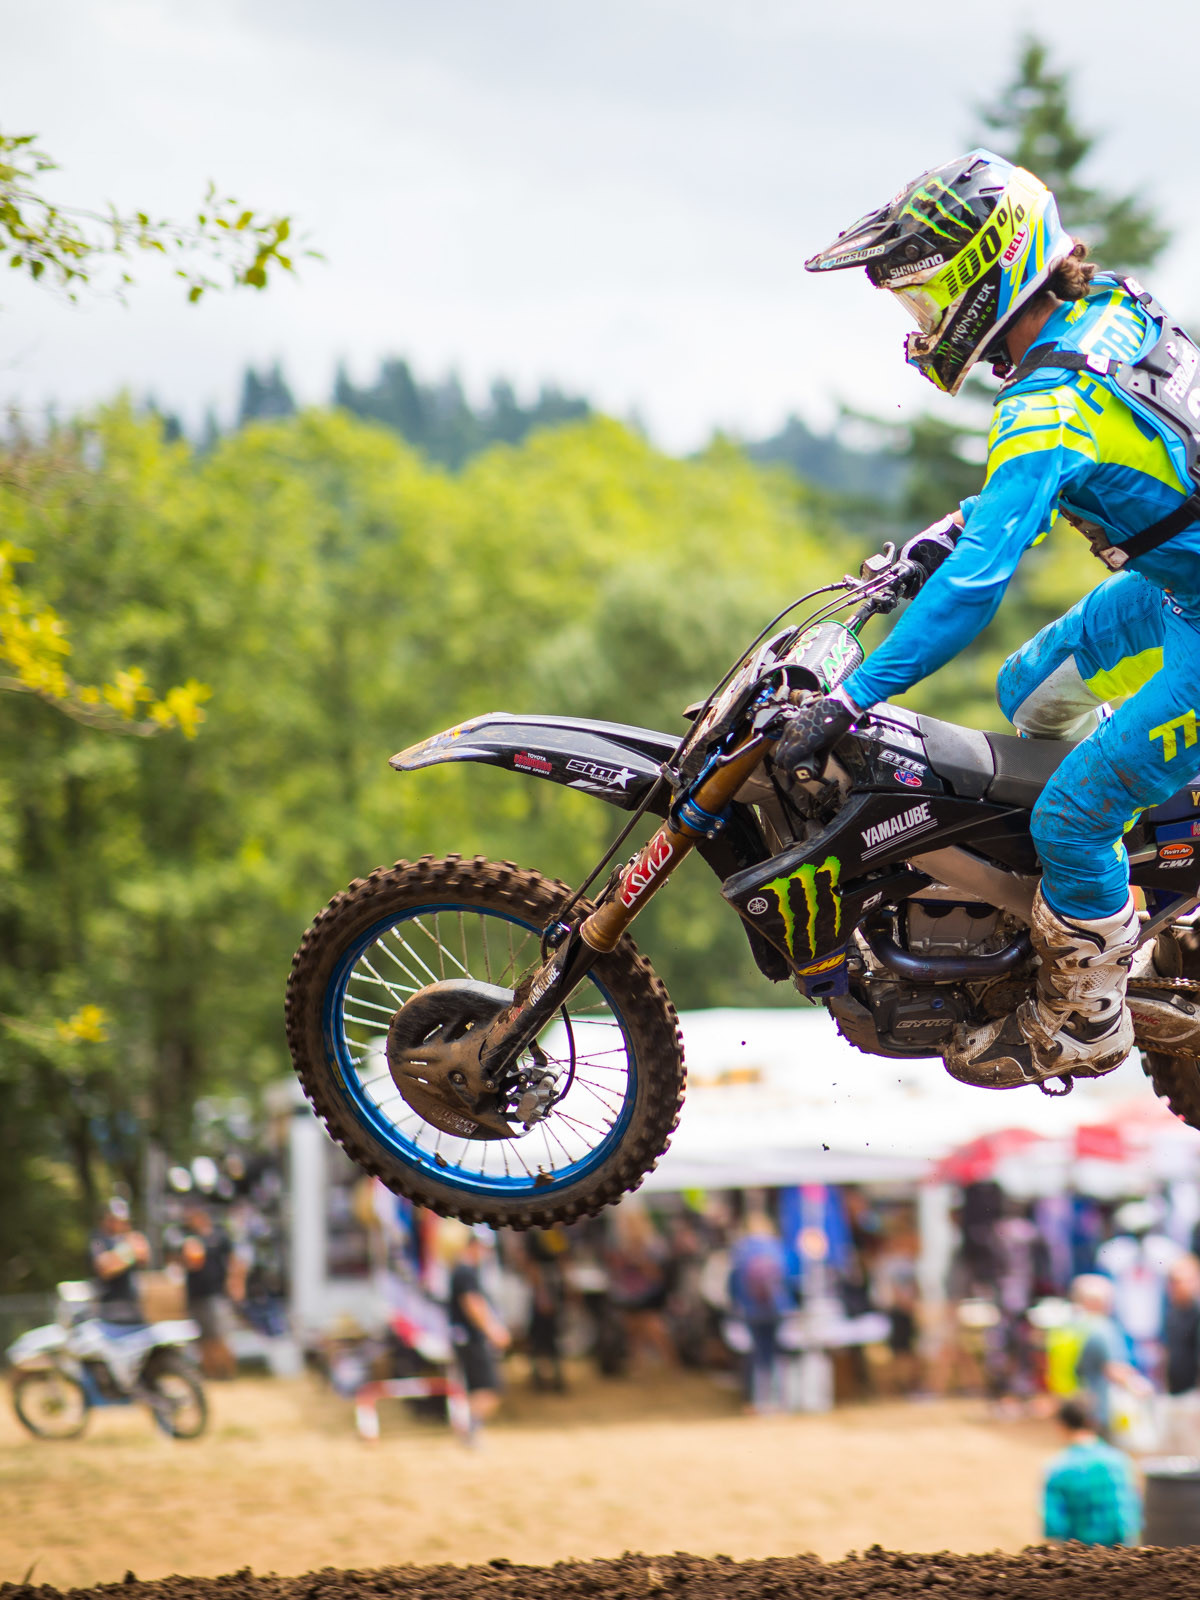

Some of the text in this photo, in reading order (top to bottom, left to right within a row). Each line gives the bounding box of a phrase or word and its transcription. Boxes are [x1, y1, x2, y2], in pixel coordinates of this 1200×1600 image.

[890, 253, 944, 279] SHIMANO
[940, 195, 1025, 299] 100%
[1003, 229, 1027, 263] BELL
[951, 282, 996, 345] MONSTER
[967, 298, 997, 341] ENERGY
[880, 749, 928, 774] GYTR
[896, 768, 915, 783] VP
[861, 803, 931, 848] YAMALUBE
[620, 831, 673, 908] KYB
